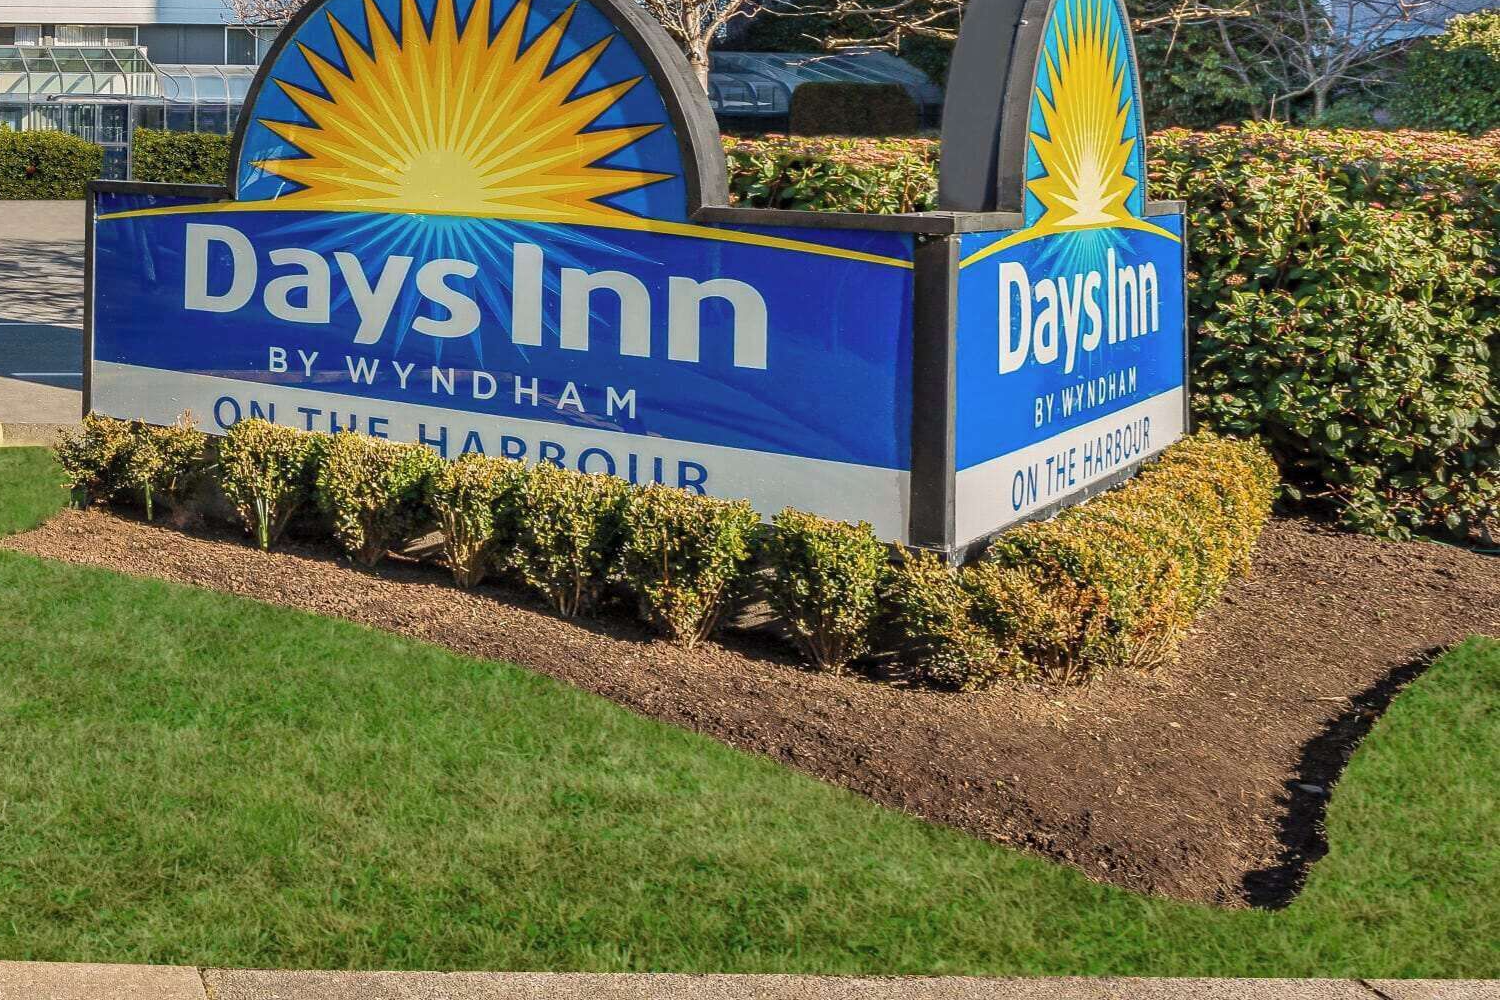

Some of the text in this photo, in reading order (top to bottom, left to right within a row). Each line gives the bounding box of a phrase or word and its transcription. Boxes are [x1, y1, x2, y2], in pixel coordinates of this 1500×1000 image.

[184, 222, 767, 370] Days Inn
[999, 247, 1159, 375] Days Inn
[213, 396, 275, 431] ON
[297, 406, 389, 439] THE
[269, 346, 637, 419] BY WYNDHAM
[1034, 366, 1138, 429] BY WYNDHAM
[1012, 416, 1151, 511] ON THE HARBOUR
